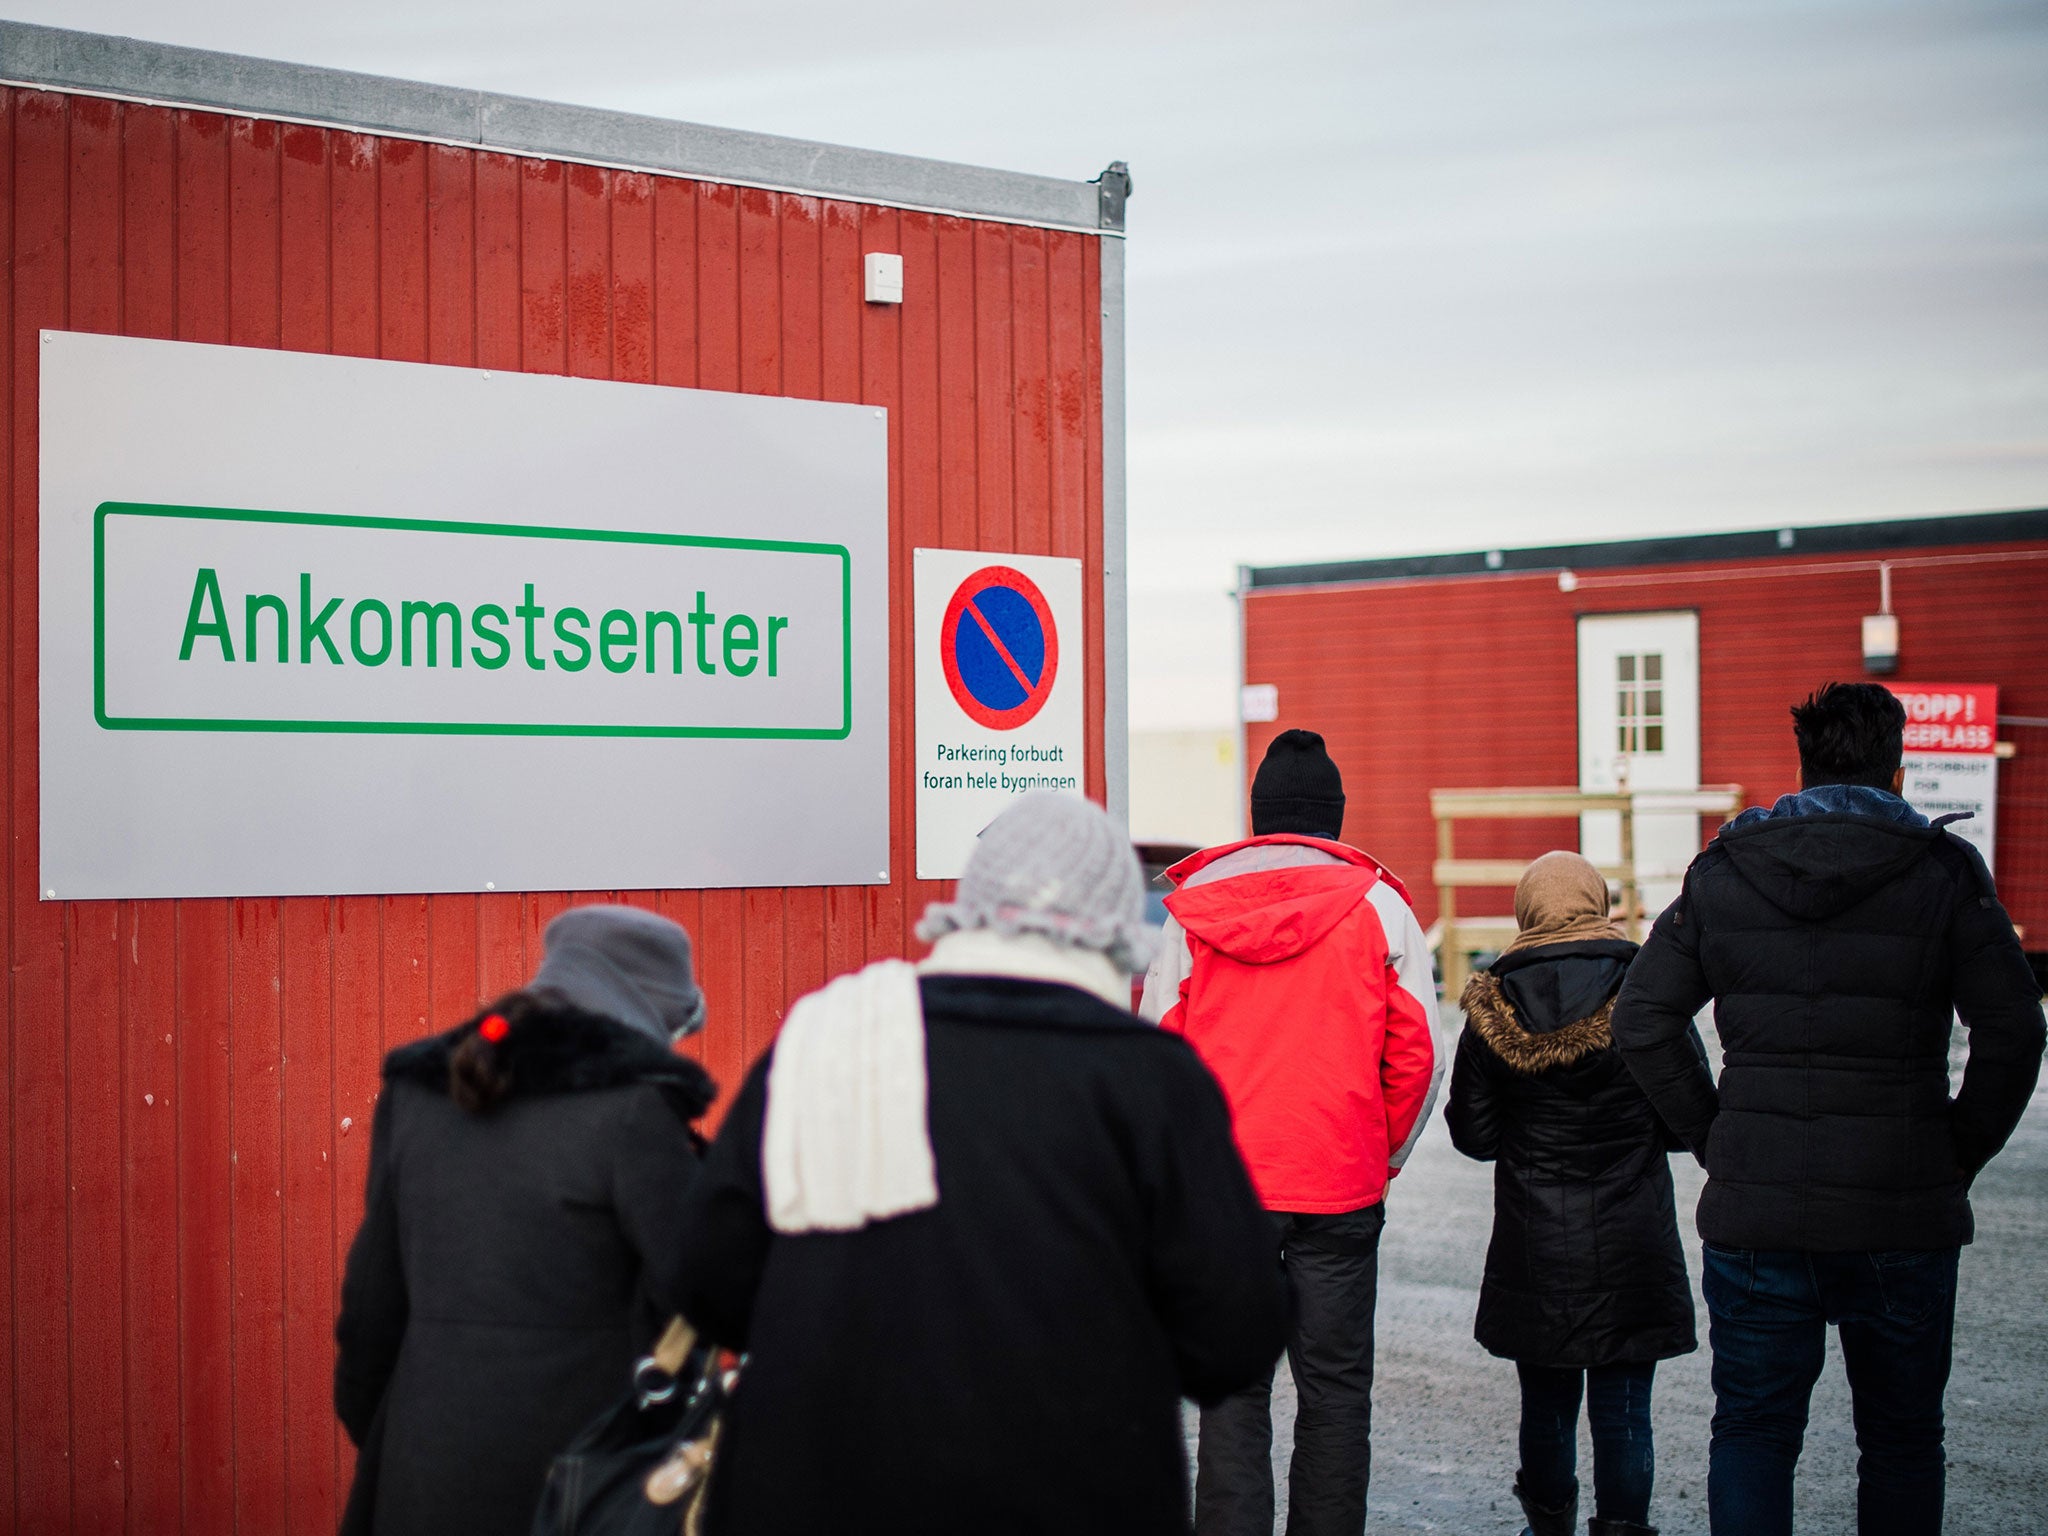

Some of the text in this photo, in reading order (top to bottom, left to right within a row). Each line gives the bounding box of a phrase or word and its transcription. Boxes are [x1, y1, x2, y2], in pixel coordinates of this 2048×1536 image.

[179, 568, 789, 677] Ankomstsenter
[1893, 692, 1963, 722] TOPP
[937, 743, 1064, 766] Parkering forbudt
[923, 771, 1076, 793] foran hele bygningen
